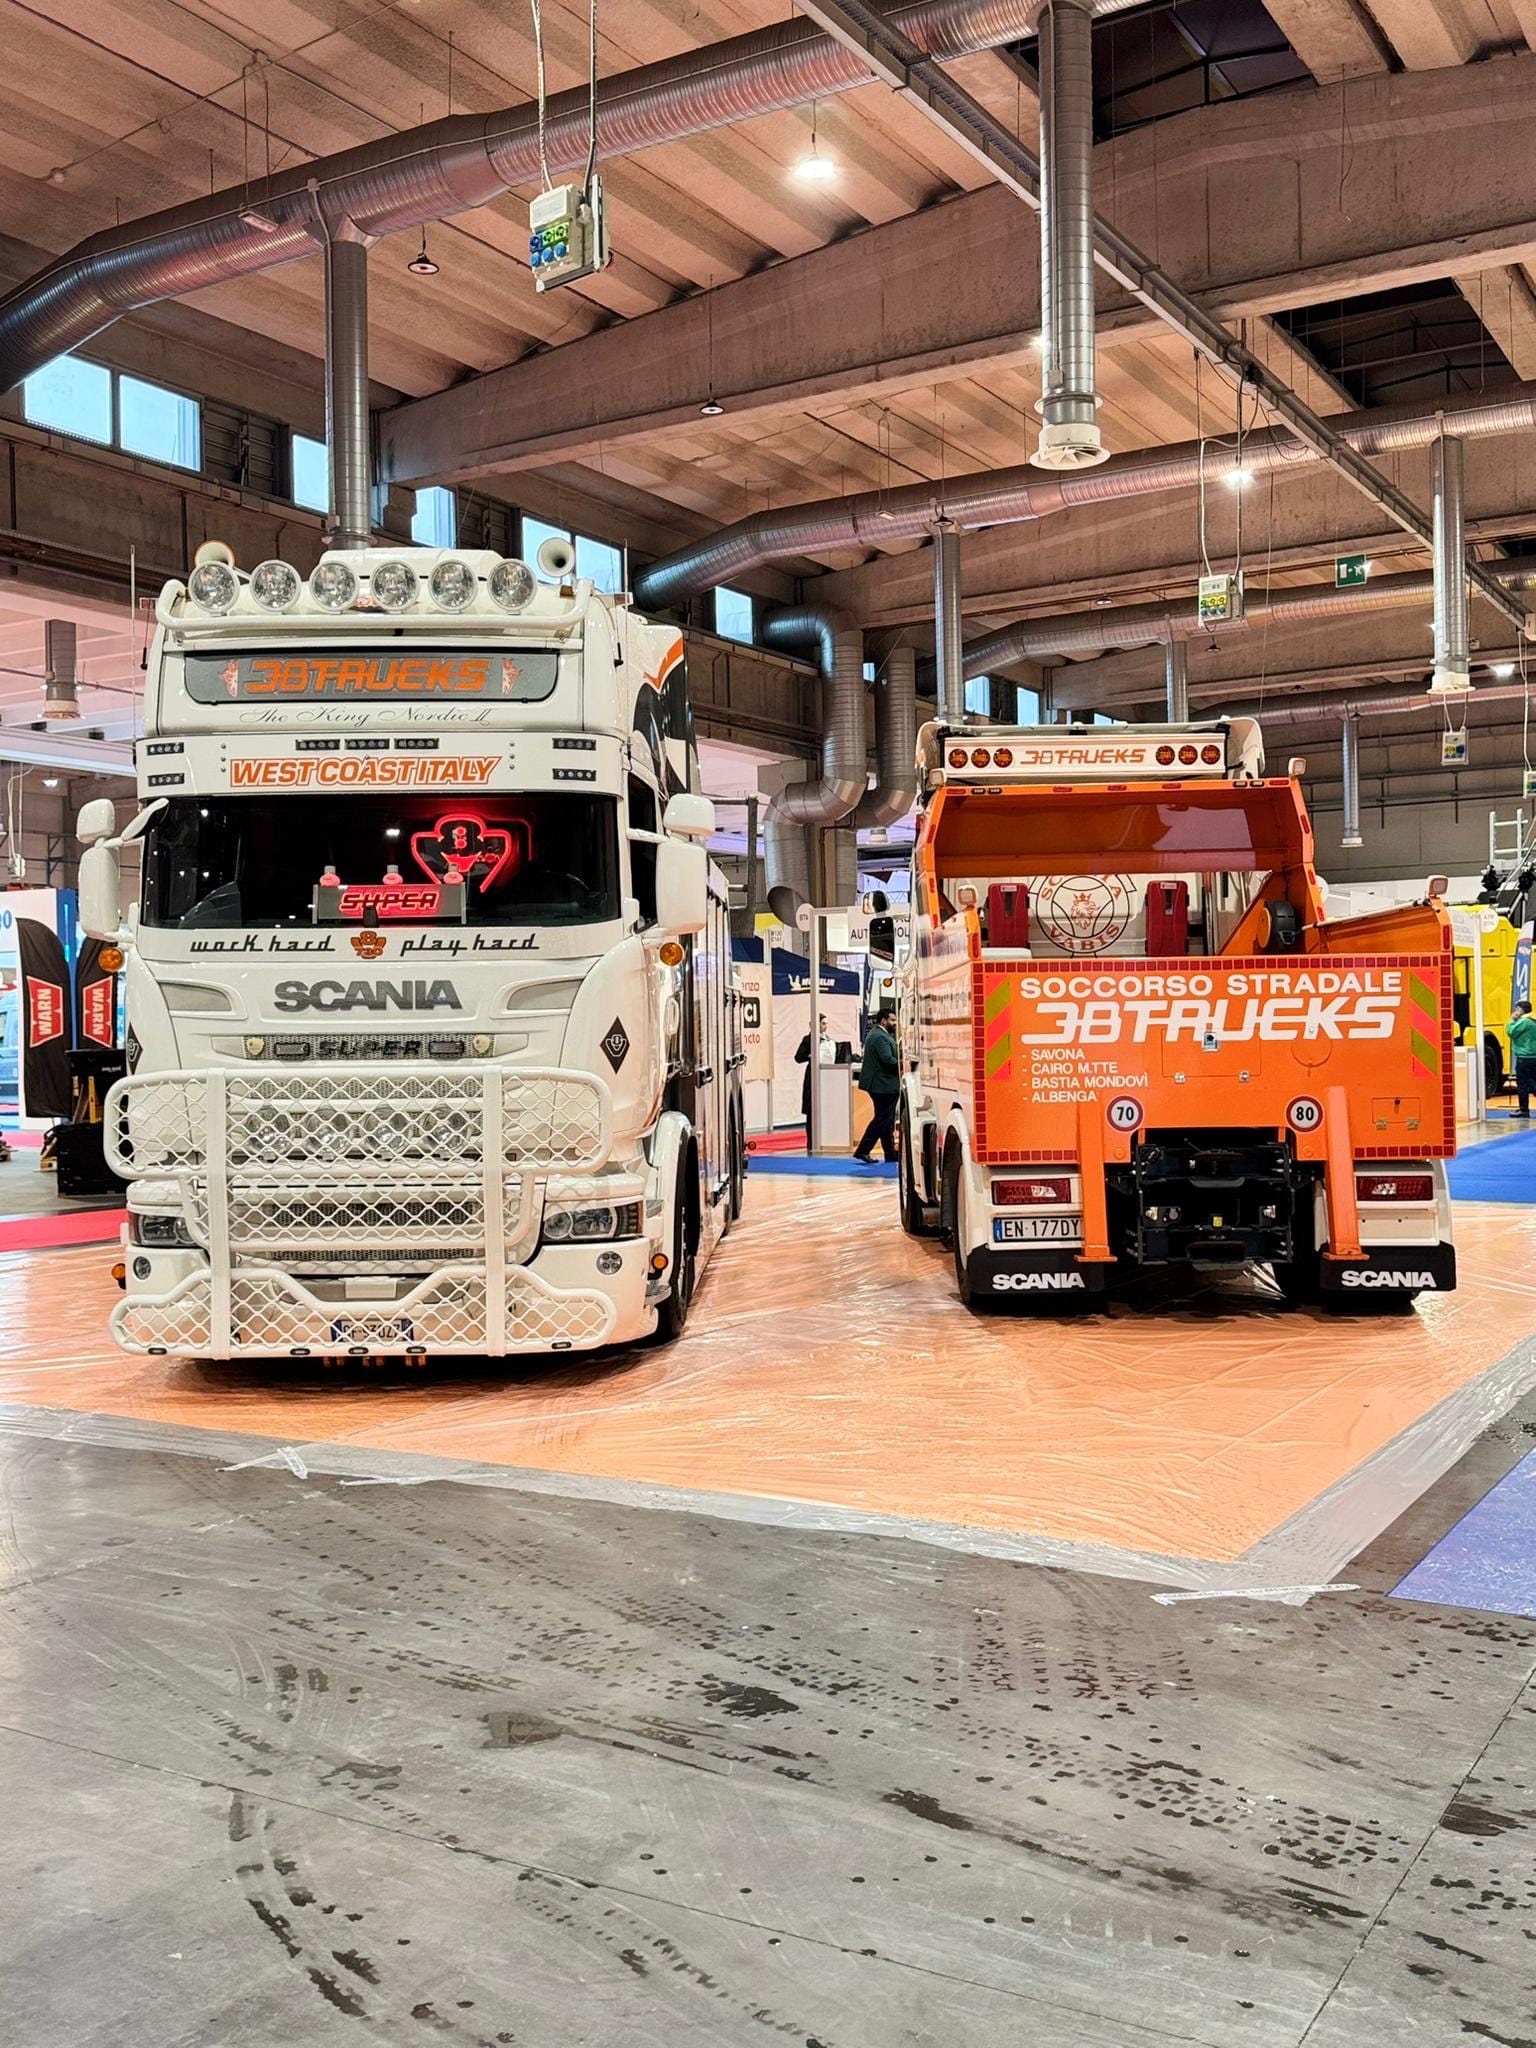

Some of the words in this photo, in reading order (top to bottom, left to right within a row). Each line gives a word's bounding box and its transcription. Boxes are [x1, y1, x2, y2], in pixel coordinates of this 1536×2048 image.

[239, 706, 288, 724] The
[296, 706, 370, 727] King
[377, 706, 467, 724] Nordic
[232, 759, 318, 786] WEST
[319, 757, 419, 784] COAST
[419, 757, 500, 783] ITALY
[339, 892, 440, 912] SUPER
[269, 935, 335, 952] hard
[400, 934, 467, 956] play
[472, 934, 540, 950] hard
[1049, 924, 1120, 951] VABIS
[1020, 976, 1213, 998] SOCCORSO
[1227, 972, 1402, 995] STRADALE
[274, 980, 462, 1012] SCANIA
[38, 988, 53, 1035] WARN
[92, 988, 104, 1035] WARN
[1020, 996, 1401, 1044] 3BTRUCKS
[319, 1039, 421, 1056] SUPER
[1031, 1048, 1085, 1060] SAVONA
[1031, 1062, 1073, 1075] CAIRO
[1078, 1061, 1118, 1073] M.TTE
[1032, 1076, 1080, 1088] BASTIA
[1085, 1073, 1148, 1088] MONDOVÌ
[1032, 1090, 1097, 1103] ALBENGA
[1117, 1106, 1134, 1121] 70
[1296, 1106, 1314, 1121] 80
[1004, 1221, 1023, 1237] EN
[1032, 1219, 1079, 1236] 177DY
[992, 1273, 1085, 1290] SCANIA
[1341, 1270, 1437, 1287] SCANIA
